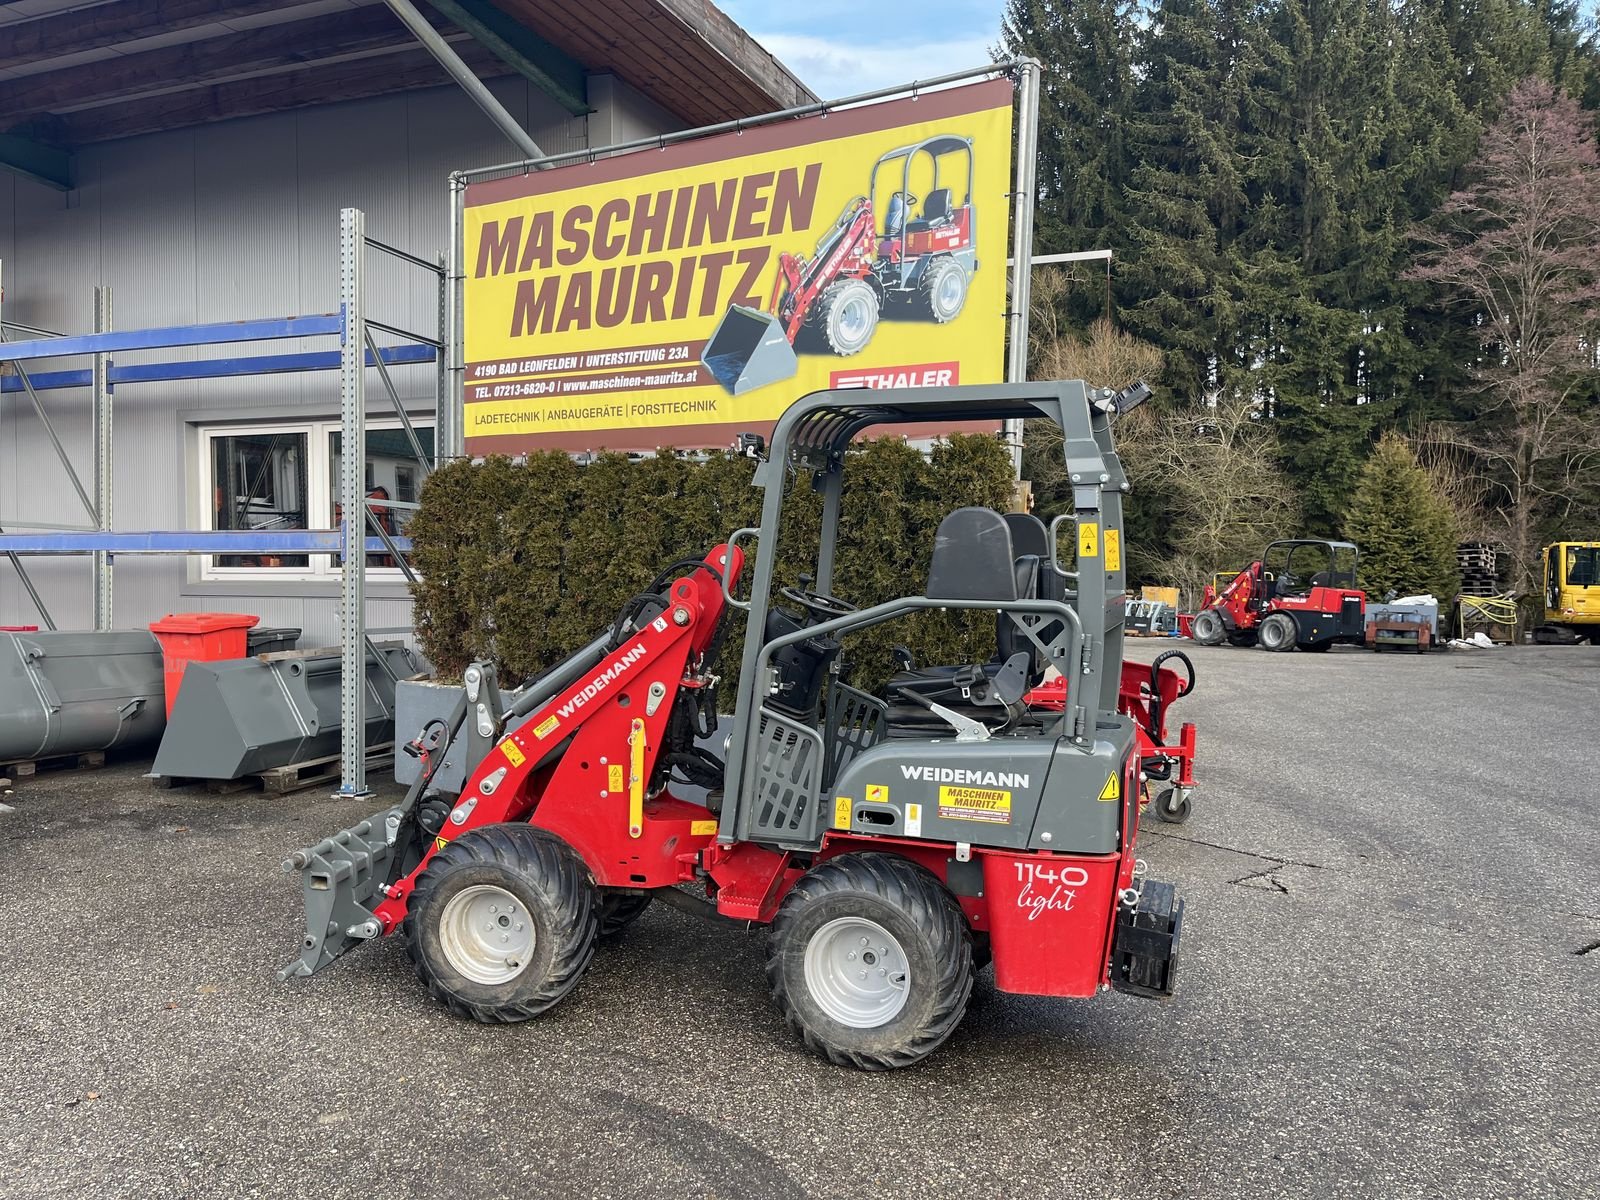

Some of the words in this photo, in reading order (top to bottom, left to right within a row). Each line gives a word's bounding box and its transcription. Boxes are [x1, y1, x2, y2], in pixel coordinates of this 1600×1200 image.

[474, 162, 823, 279] MASCHINEN
[510, 245, 772, 338] MAURITZ
[474, 366, 497, 377] 4190
[499, 364, 517, 375] BAD
[519, 356, 577, 373] LEONFELDEN
[586, 349, 666, 367] UNTERSTIFTUNG
[668, 346, 689, 360] 23A
[475, 387, 492, 399] TEL.
[494, 381, 555, 397] 07213-6820-0
[563, 370, 698, 392] www.maschinen-mauritz.at
[863, 369, 952, 389] THALER
[475, 411, 540, 425] LADETECHNIK
[547, 404, 623, 420] ANBAUGERÄTE
[631, 400, 717, 416] FORSTTECHNIK
[557, 643, 647, 718] WEIDEMANN
[900, 765, 1029, 788] WEIDEMANN
[947, 788, 1004, 801] MASCHINEN
[954, 798, 997, 809] MAURITZ
[1014, 862, 1089, 886] 1140
[1017, 883, 1077, 921] light
